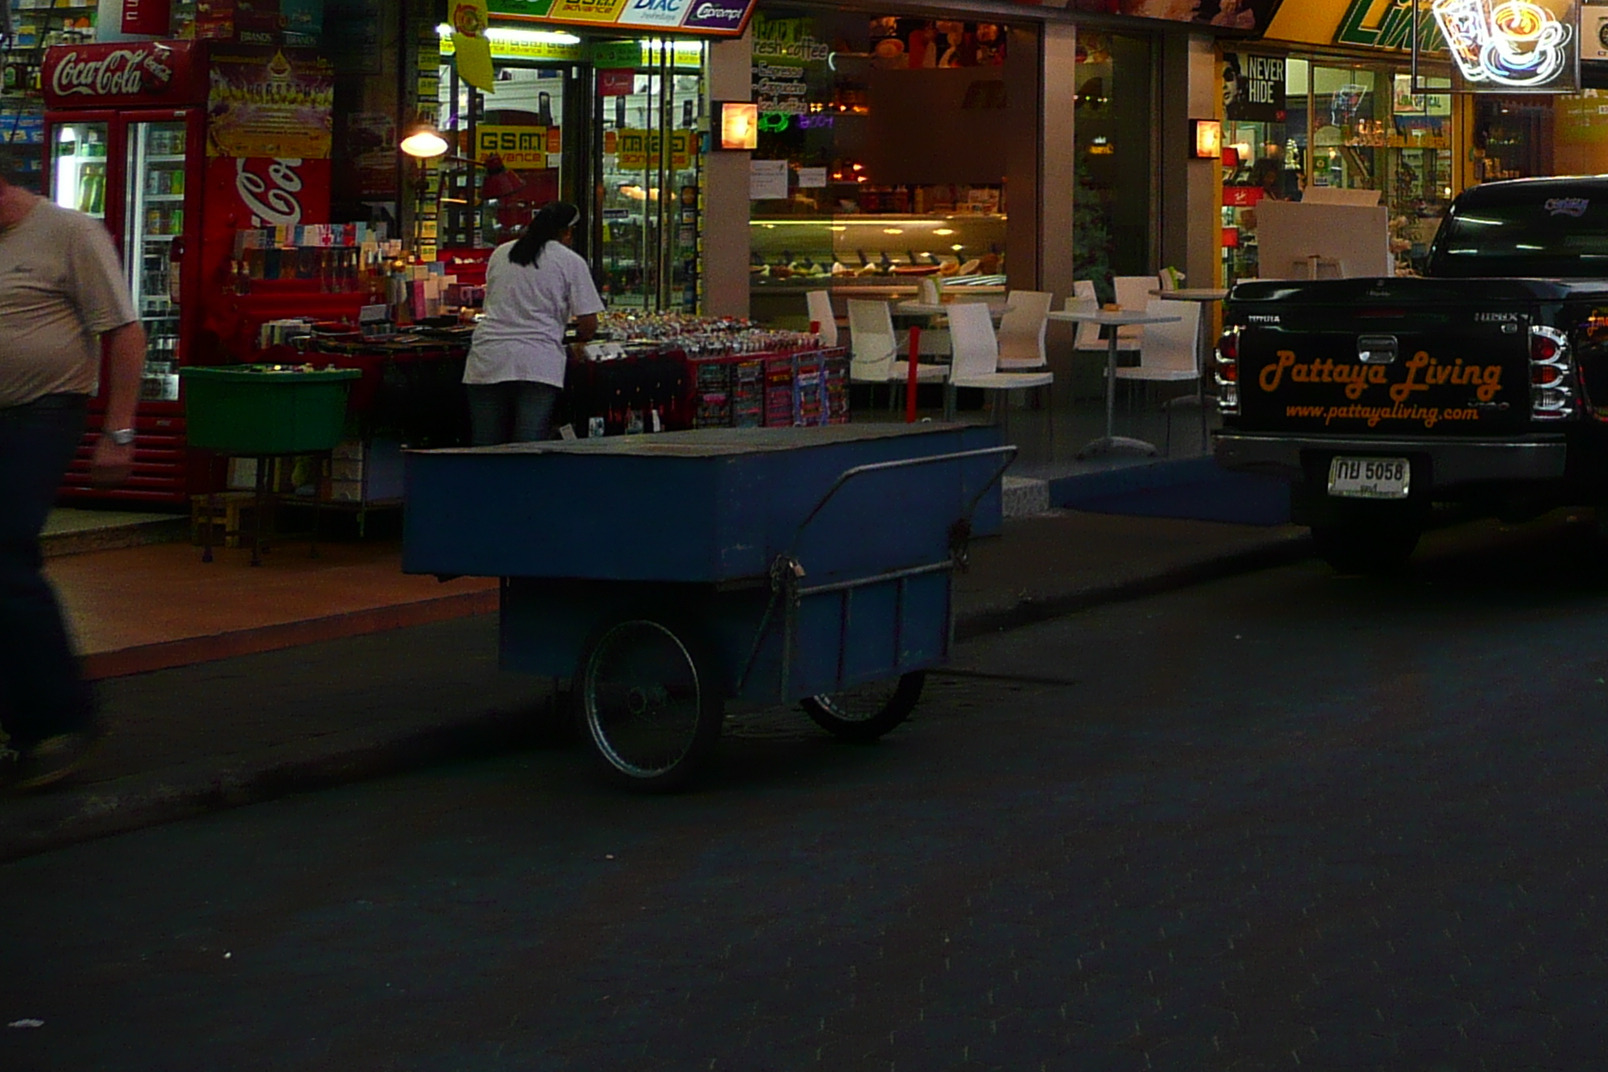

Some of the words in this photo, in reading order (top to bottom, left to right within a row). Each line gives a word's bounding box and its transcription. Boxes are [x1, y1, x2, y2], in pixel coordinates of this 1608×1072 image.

[562, 3, 612, 15] advance
[785, 37, 829, 61] coffee
[52, 48, 148, 97] Coca-Cola
[1249, 56, 1284, 81] NEVER
[1249, 79, 1274, 103] HIDE
[480, 133, 542, 151] GSM
[1258, 348, 1389, 401] Pattaya
[1388, 349, 1503, 403] Living
[1285, 401, 1480, 430] www.pattayaliving.com
[1365, 462, 1403, 481] 5058
